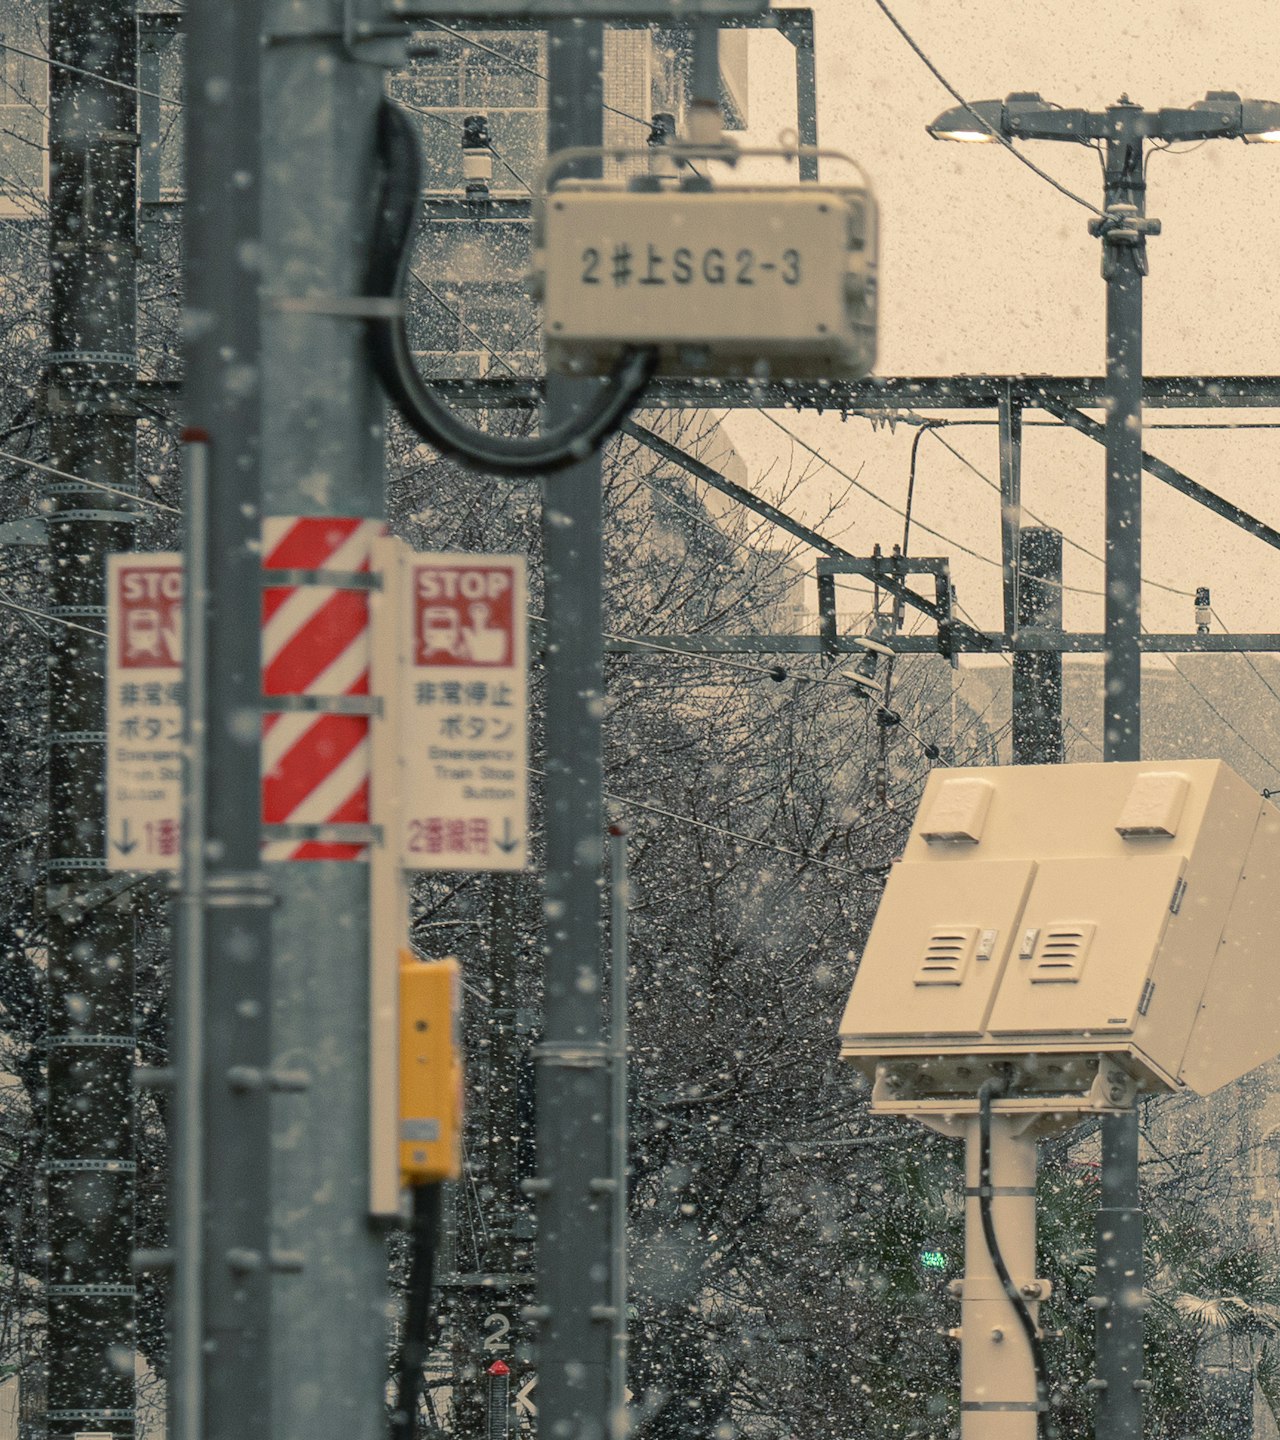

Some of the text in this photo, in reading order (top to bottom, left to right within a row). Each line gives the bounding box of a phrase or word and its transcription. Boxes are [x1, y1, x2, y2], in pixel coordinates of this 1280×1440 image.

[123, 571, 182, 600] STO
[418, 570, 509, 599] STOP
[415, 681, 514, 707] 非常停止
[439, 713, 514, 740] ボタン
[408, 817, 489, 854] 2番線用
[484, 1313, 510, 1349] 2
